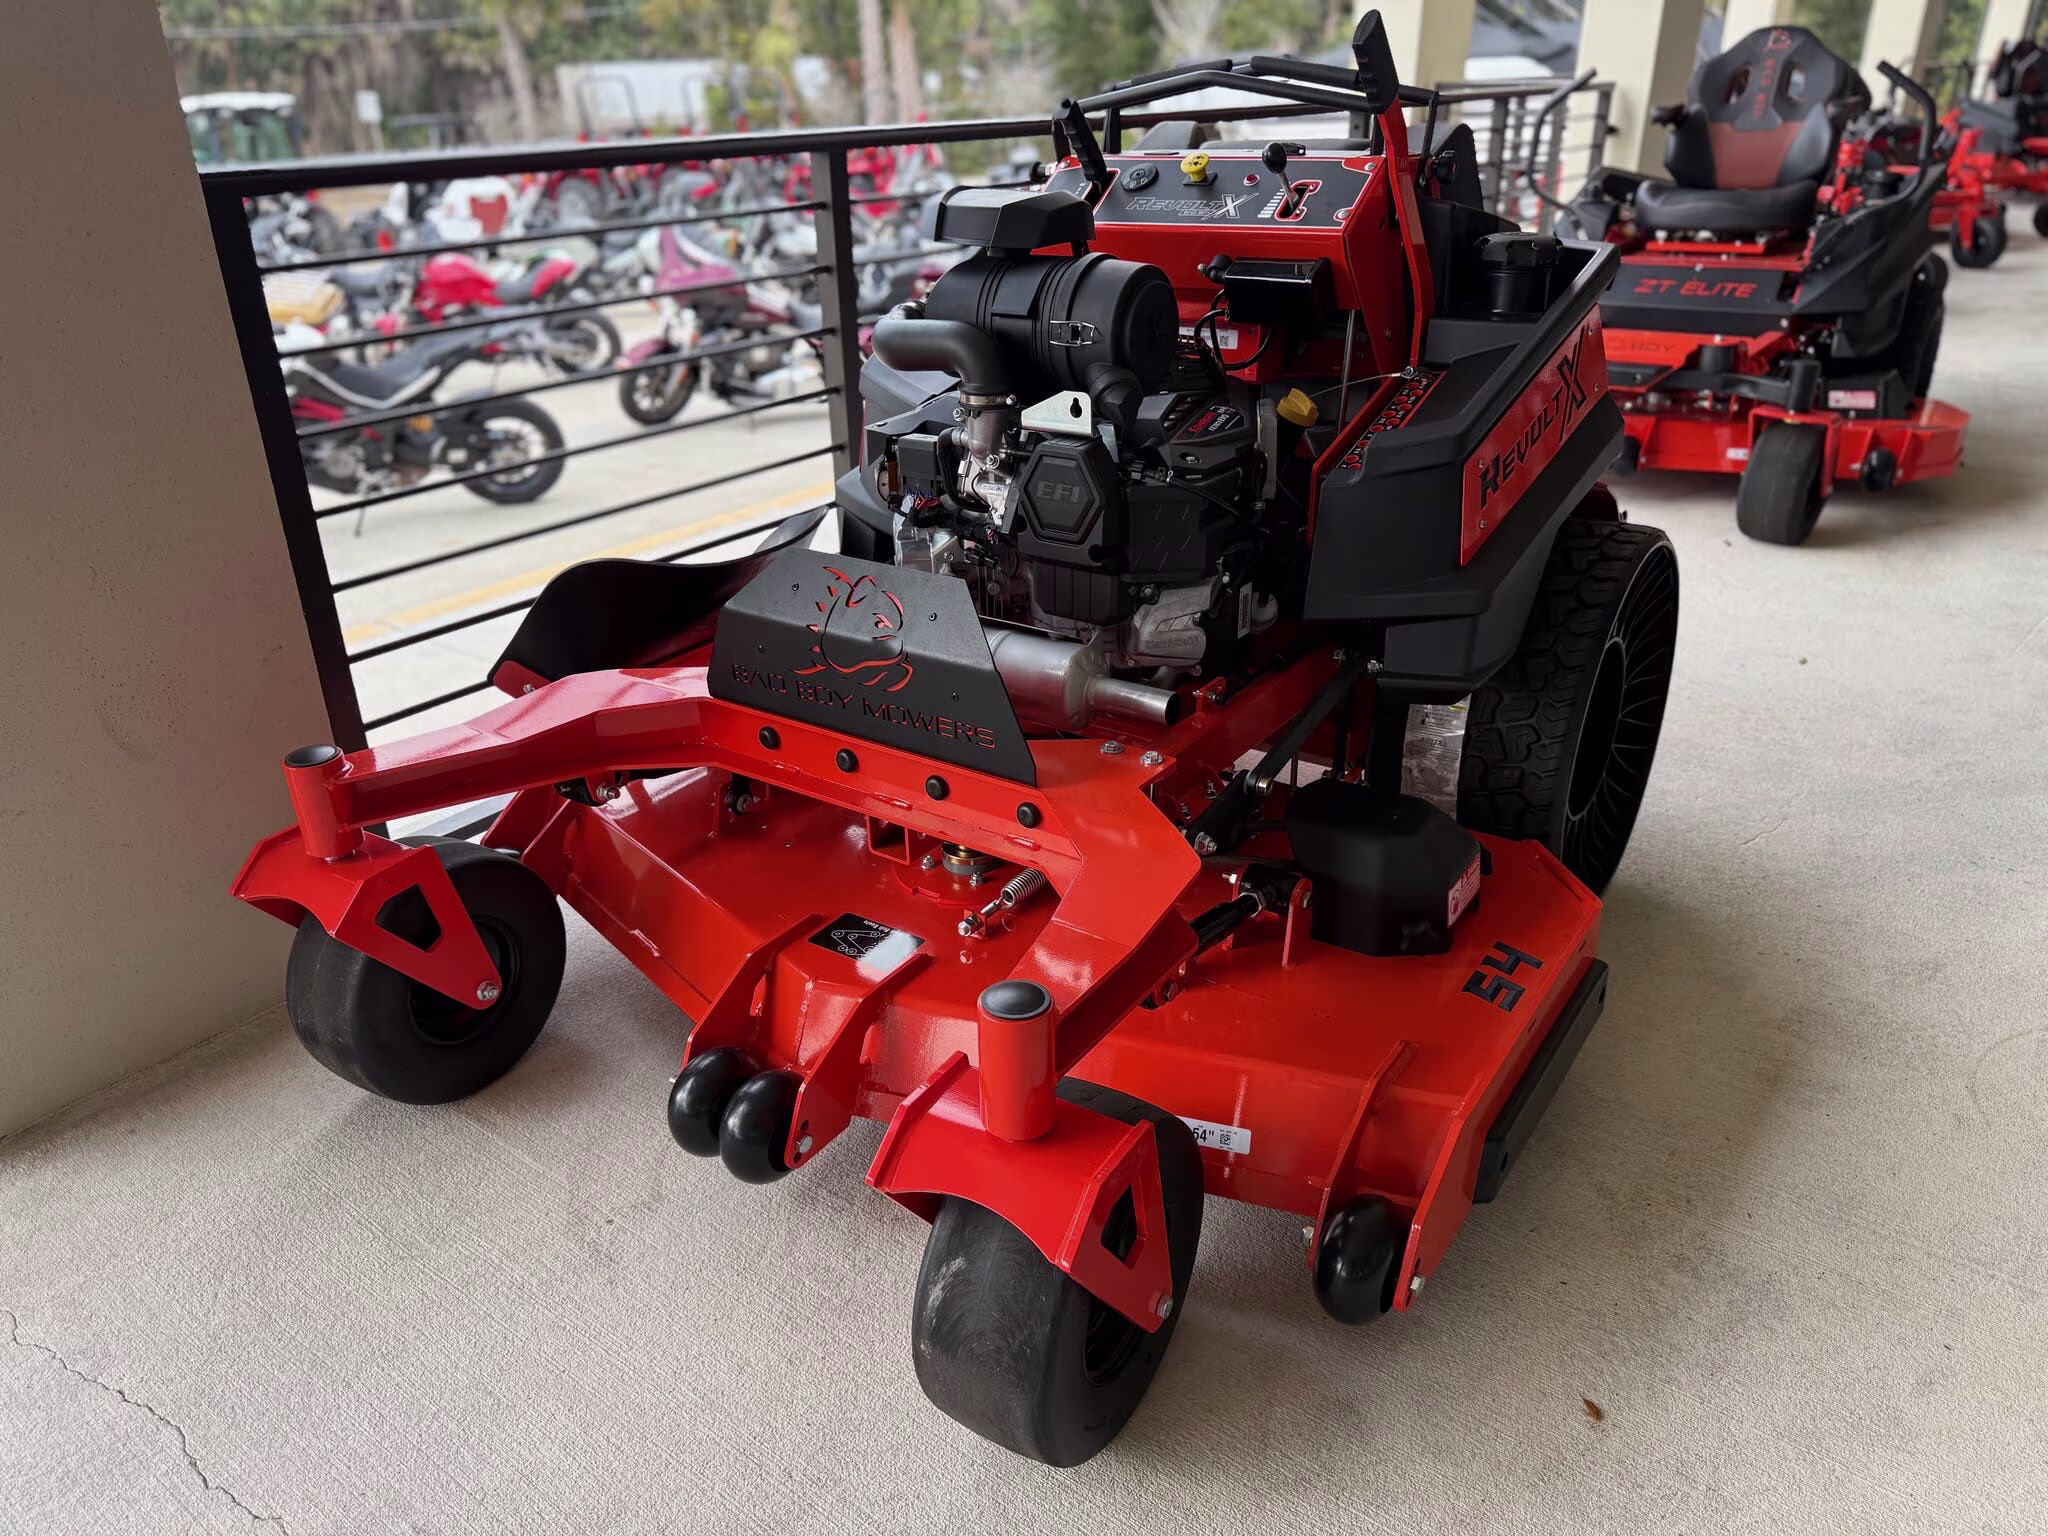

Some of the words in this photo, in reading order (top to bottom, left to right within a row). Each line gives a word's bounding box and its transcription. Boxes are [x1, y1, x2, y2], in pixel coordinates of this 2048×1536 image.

[1634, 278, 1676, 294] ZT
[1680, 280, 1757, 298] ELITE
[1036, 481, 1081, 503] EFI
[731, 664, 787, 694] BAD
[796, 679, 854, 709] BOY
[862, 697, 997, 750] MOWERS
[1461, 940, 1544, 1013] 54
